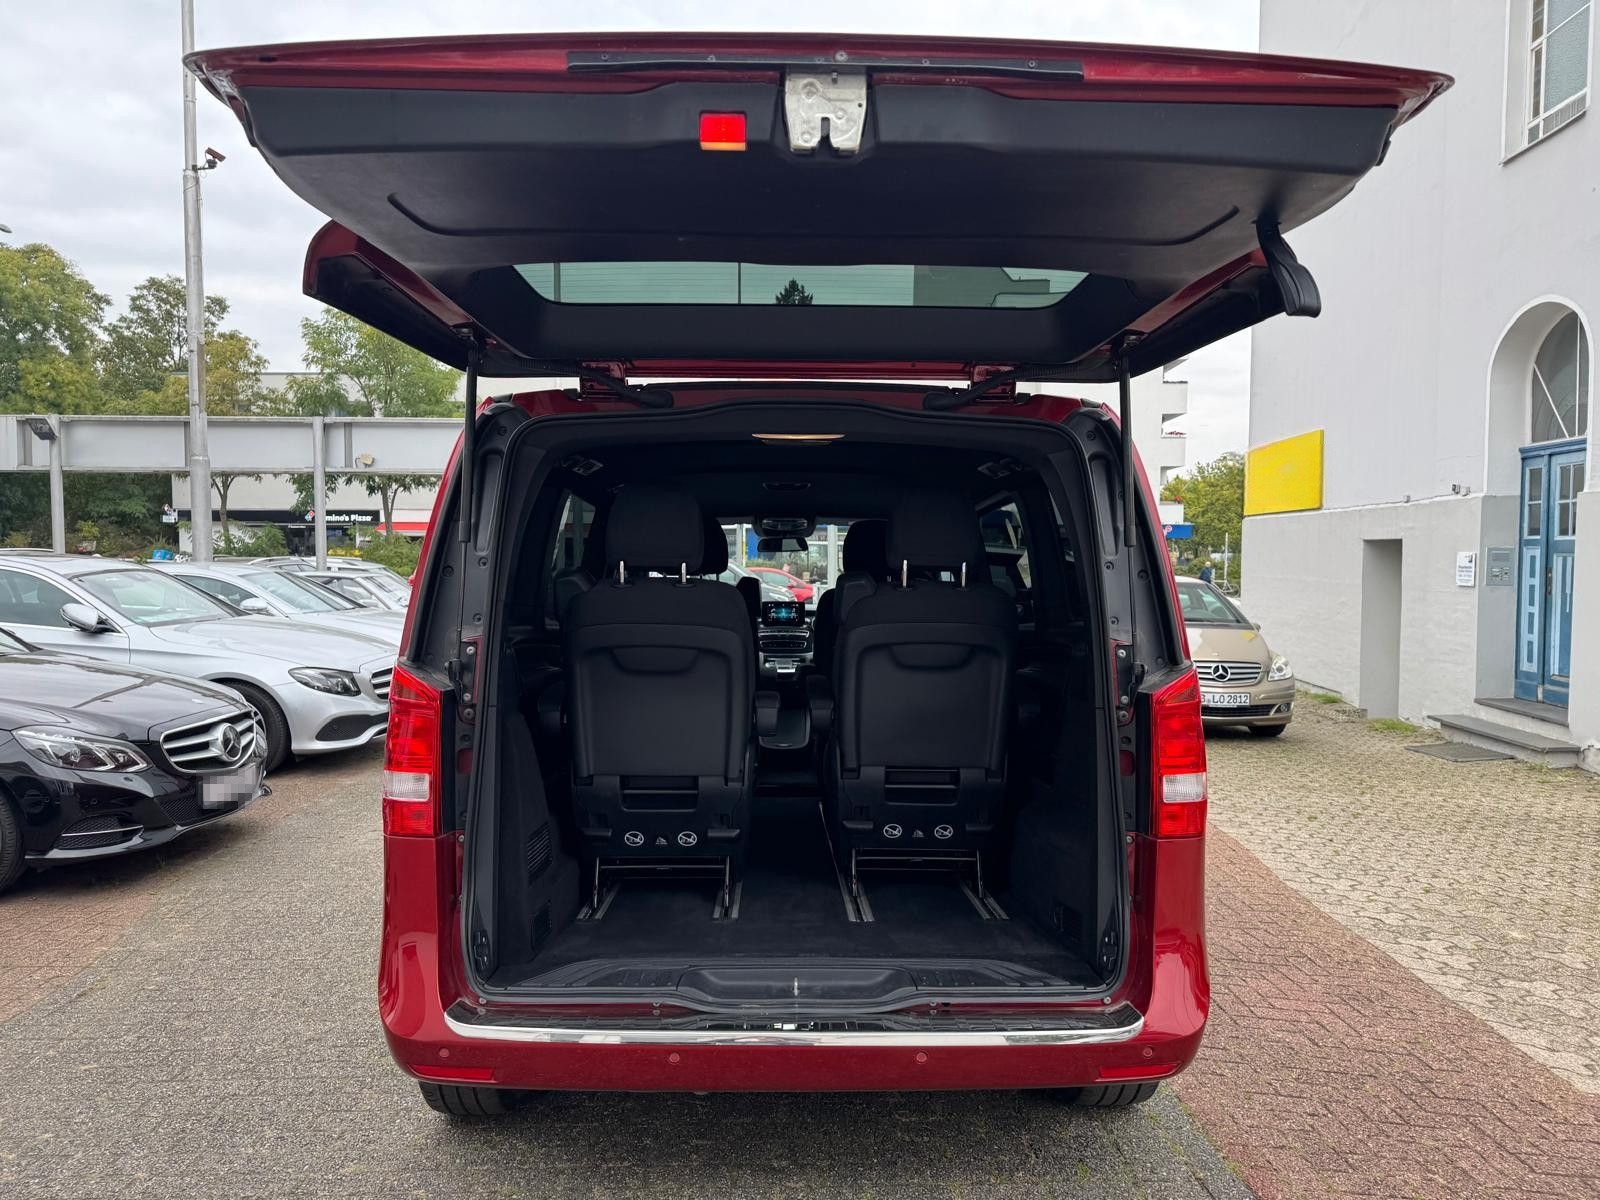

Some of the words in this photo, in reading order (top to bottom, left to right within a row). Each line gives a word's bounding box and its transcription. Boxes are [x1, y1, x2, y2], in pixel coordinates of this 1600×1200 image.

[325, 514, 349, 522] mino's
[351, 514, 372, 522] Pizza
[1212, 694, 1225, 704] LO
[1227, 694, 1249, 704] 2812
